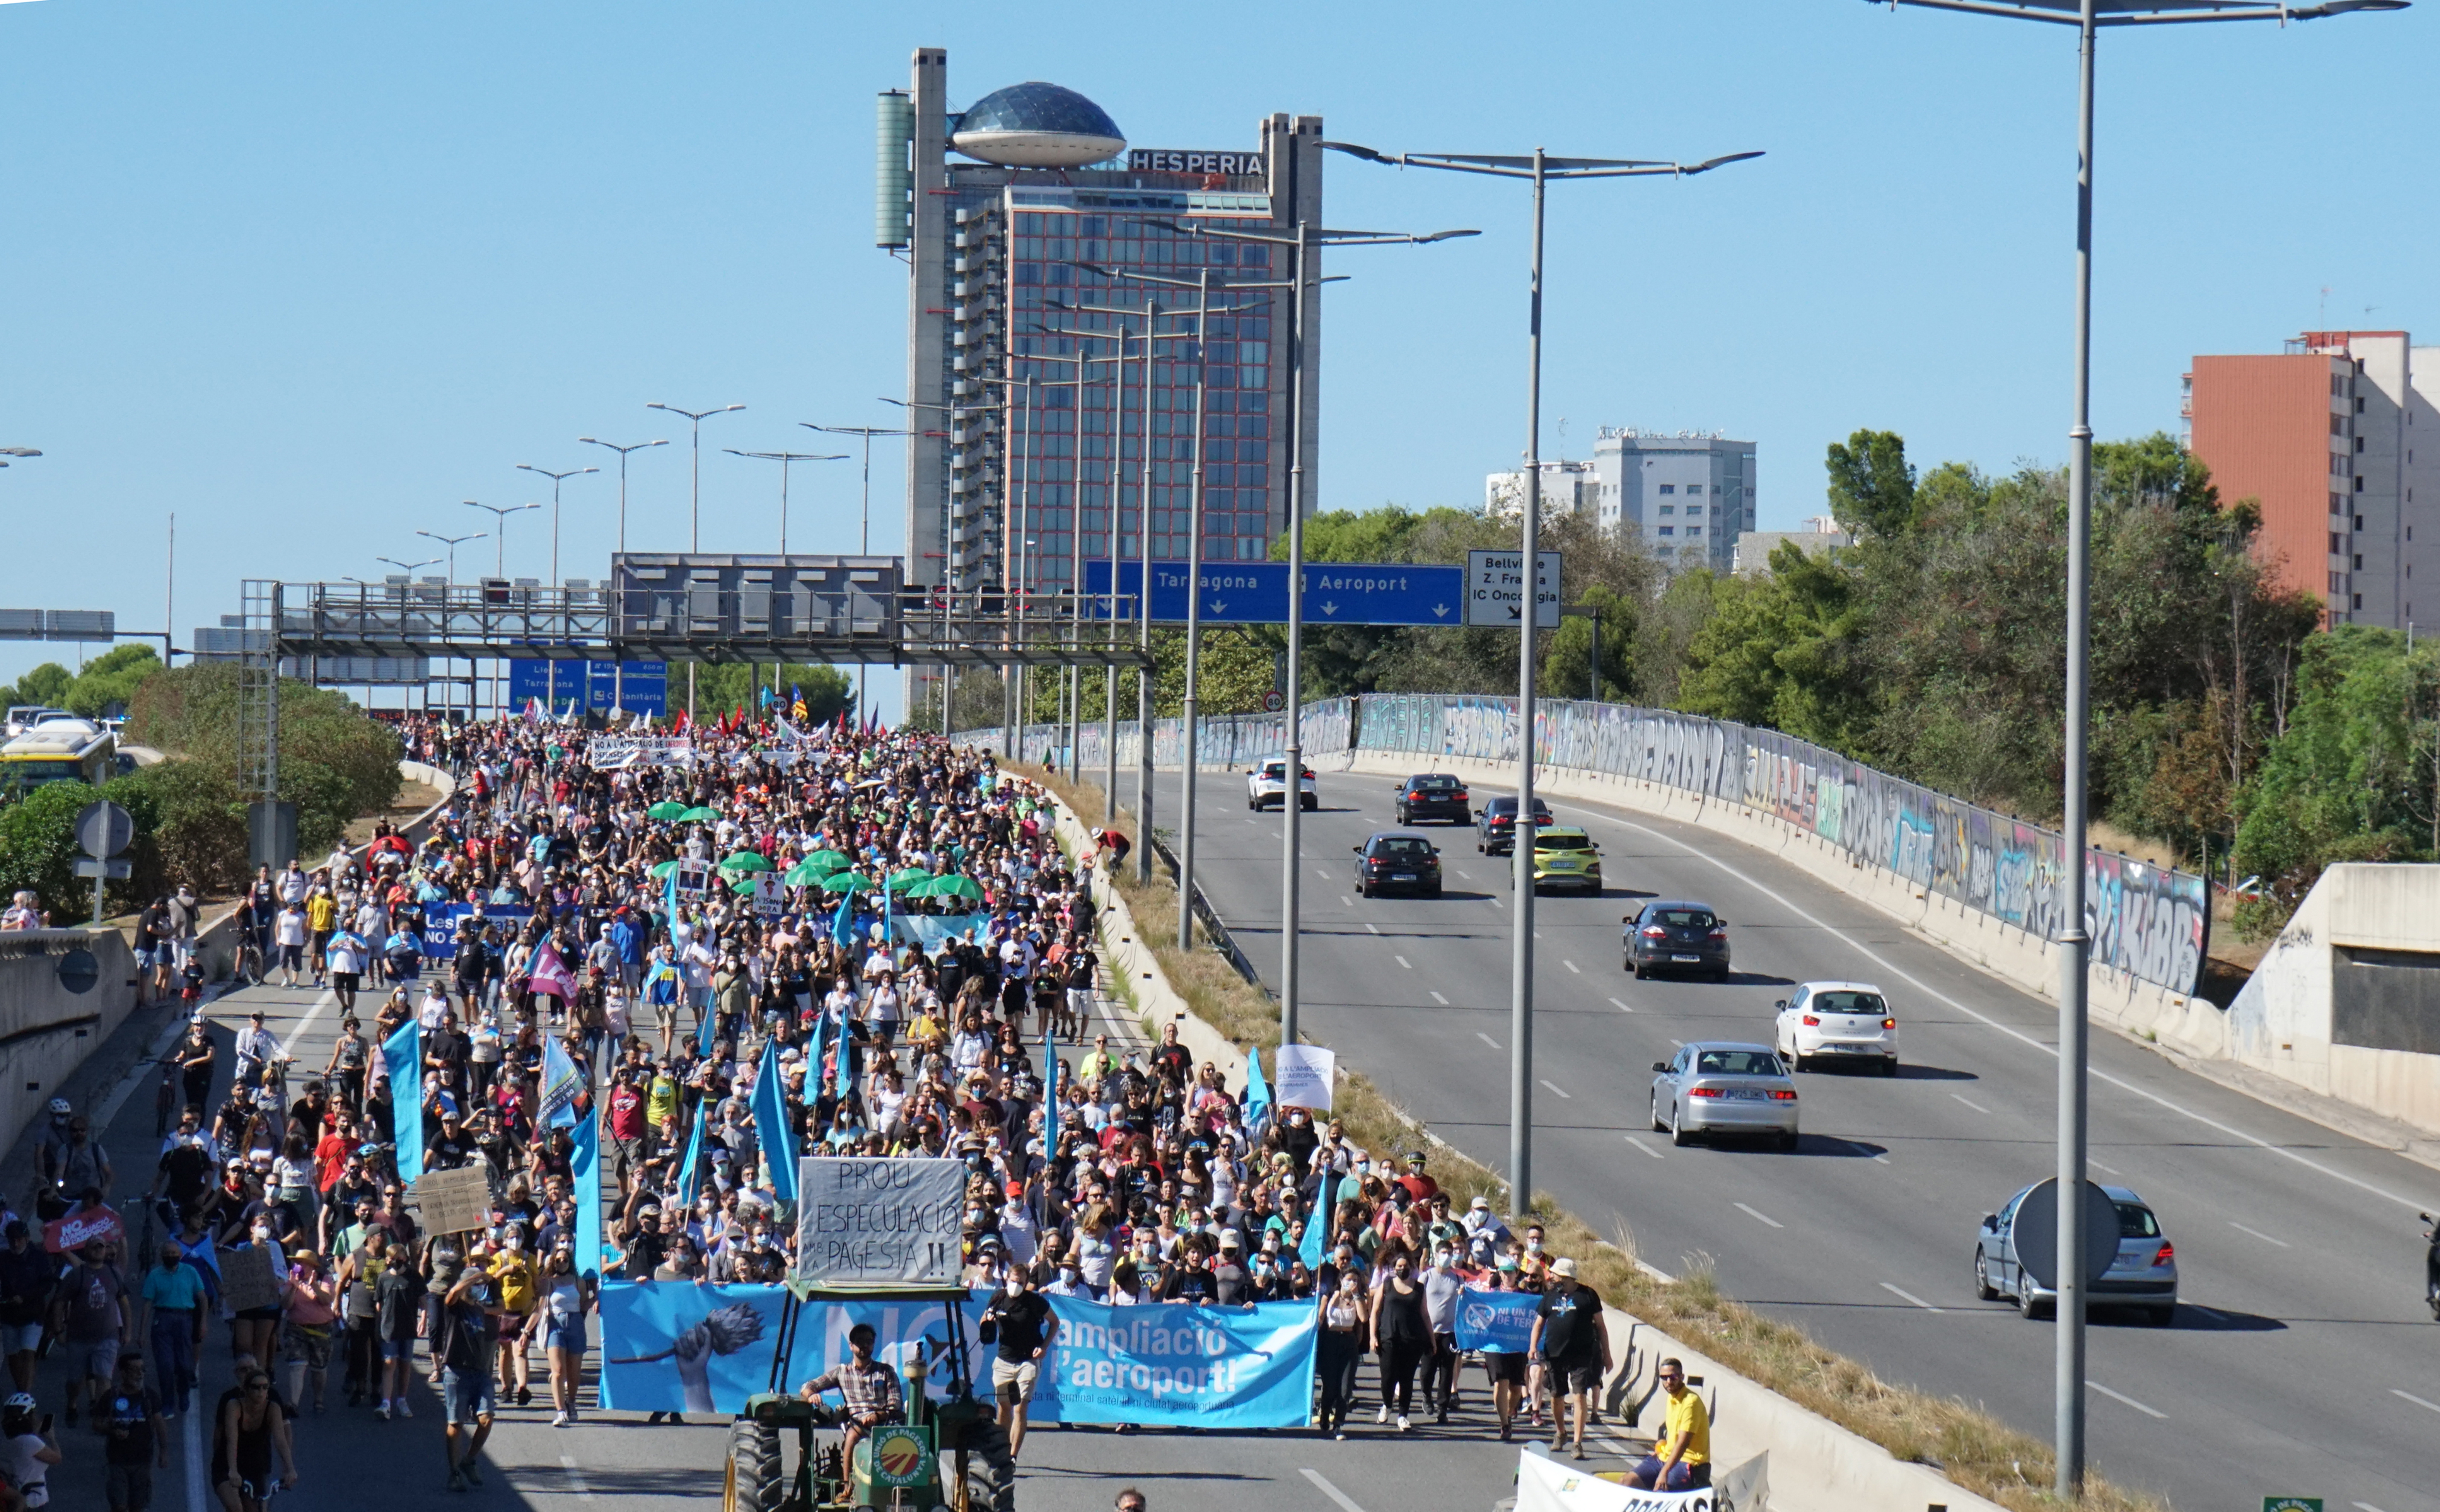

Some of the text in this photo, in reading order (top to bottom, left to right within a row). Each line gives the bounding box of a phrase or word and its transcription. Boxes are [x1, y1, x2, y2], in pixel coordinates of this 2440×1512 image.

[1133, 152, 1263, 175] HESPERIA
[1159, 572, 1257, 591] Taragona
[1319, 575, 1407, 592] Aeroport
[1484, 573, 1495, 583] Z.
[1473, 590, 1486, 600] IC
[679, 860, 686, 869] I
[426, 914, 454, 929] Les
[425, 931, 446, 944] NO
[839, 1161, 910, 1190] PROU
[818, 1199, 959, 1234] ESPECULACIÓ
[62, 1220, 83, 1236] NO
[803, 1242, 824, 1253] AMB
[804, 1259, 819, 1272] LA
[828, 1239, 919, 1278] PAGESIA
[1497, 1315, 1510, 1326] DE
[1512, 1308, 1526, 1317] UN
[1053, 1319, 1227, 1358] ampliació
[824, 1306, 984, 1397] NO
[1050, 1350, 1235, 1398] l'aeroport!
[1046, 1393, 1054, 1401] ni
[1058, 1393, 1094, 1403] terminal
[1133, 1397, 1142, 1407] ni
[1144, 1399, 1171, 1409] ciutat
[874, 1429, 926, 1457] UNIÓ DE PAGESOS
[874, 1460, 926, 1484] DE CATALUNYA
